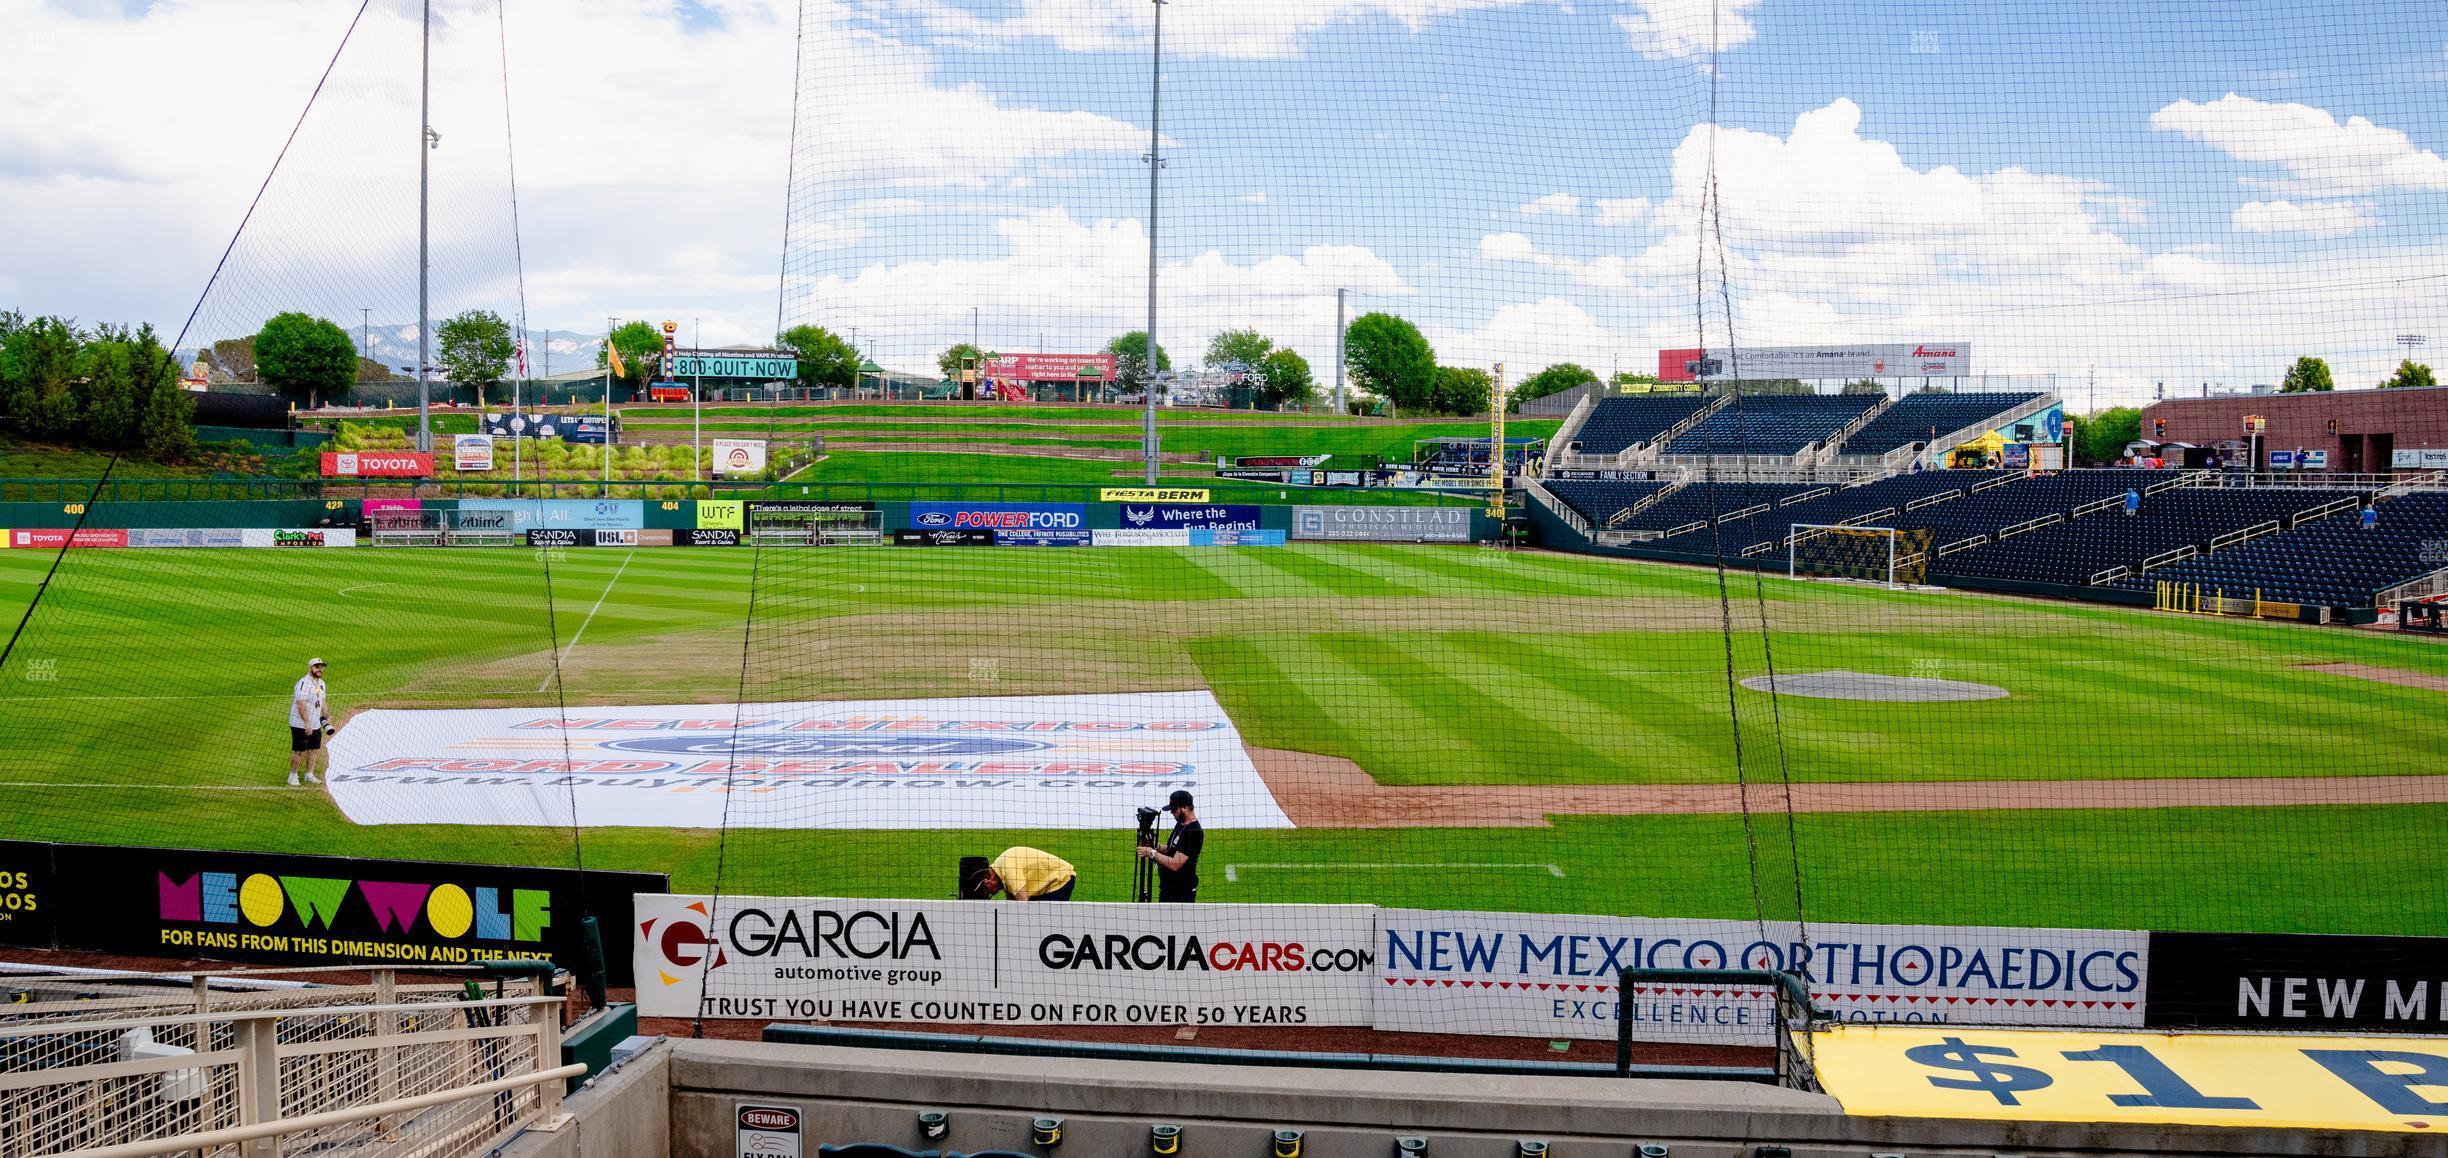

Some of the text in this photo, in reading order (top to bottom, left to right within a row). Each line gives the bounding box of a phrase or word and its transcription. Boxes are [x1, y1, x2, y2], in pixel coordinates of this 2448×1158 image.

[1745, 351, 1792, 360] Comfortable.
[1816, 350, 1844, 359] Amana
[1847, 350, 1871, 358] brand.
[1911, 345, 1957, 358] Amana
[1044, 357, 1068, 366] working
[1031, 371, 1045, 379] right
[362, 458, 418, 470] TOYOTA
[1600, 470, 1647, 480] FAMILY SECTION
[1106, 490, 1204, 500] FIESTA BERM
[63, 503, 85, 514] 400
[661, 501, 679, 511] 404
[702, 506, 736, 519] WTF
[922, 514, 946, 525] Ford
[1162, 507, 1227, 521] Where the
[1334, 508, 1462, 524] GONSTEAD
[1485, 508, 1502, 518] 340
[273, 529, 324, 541] Clark's Pet
[530, 530, 576, 540] SANDIA
[597, 531, 623, 543] USL
[691, 530, 736, 540] SANDIA
[510, 718, 1226, 732] NEW MEXICO
[355, 757, 1196, 776] FORD DEALERS
[332, 773, 1198, 789] www.buyfordnow.com
[0, 893, 37, 911] OS
[158, 869, 550, 942] MEOW WOLF
[729, 908, 941, 960] GARCIA
[161, 929, 193, 946] FOR
[197, 931, 237, 949] FANS
[241, 934, 289, 952] FROM
[291, 937, 328, 954] THIS
[331, 940, 427, 961] DIMENSION
[429, 946, 468, 963] AND
[471, 949, 503, 961] THE
[1039, 933, 1374, 972] GARCIACARS.COM
[1387, 929, 2139, 993] NEW MEXICO ORTHOPAEDICS
[775, 965, 942, 986] automotive group
[2238, 977, 2366, 1019] NEW
[704, 997, 1307, 1024] TRUST YOU HAVE COUNTED ON FOR OVER 50 YEARS
[1904, 1037, 2263, 1111] $1
[747, 1113, 790, 1126] BEWARE
